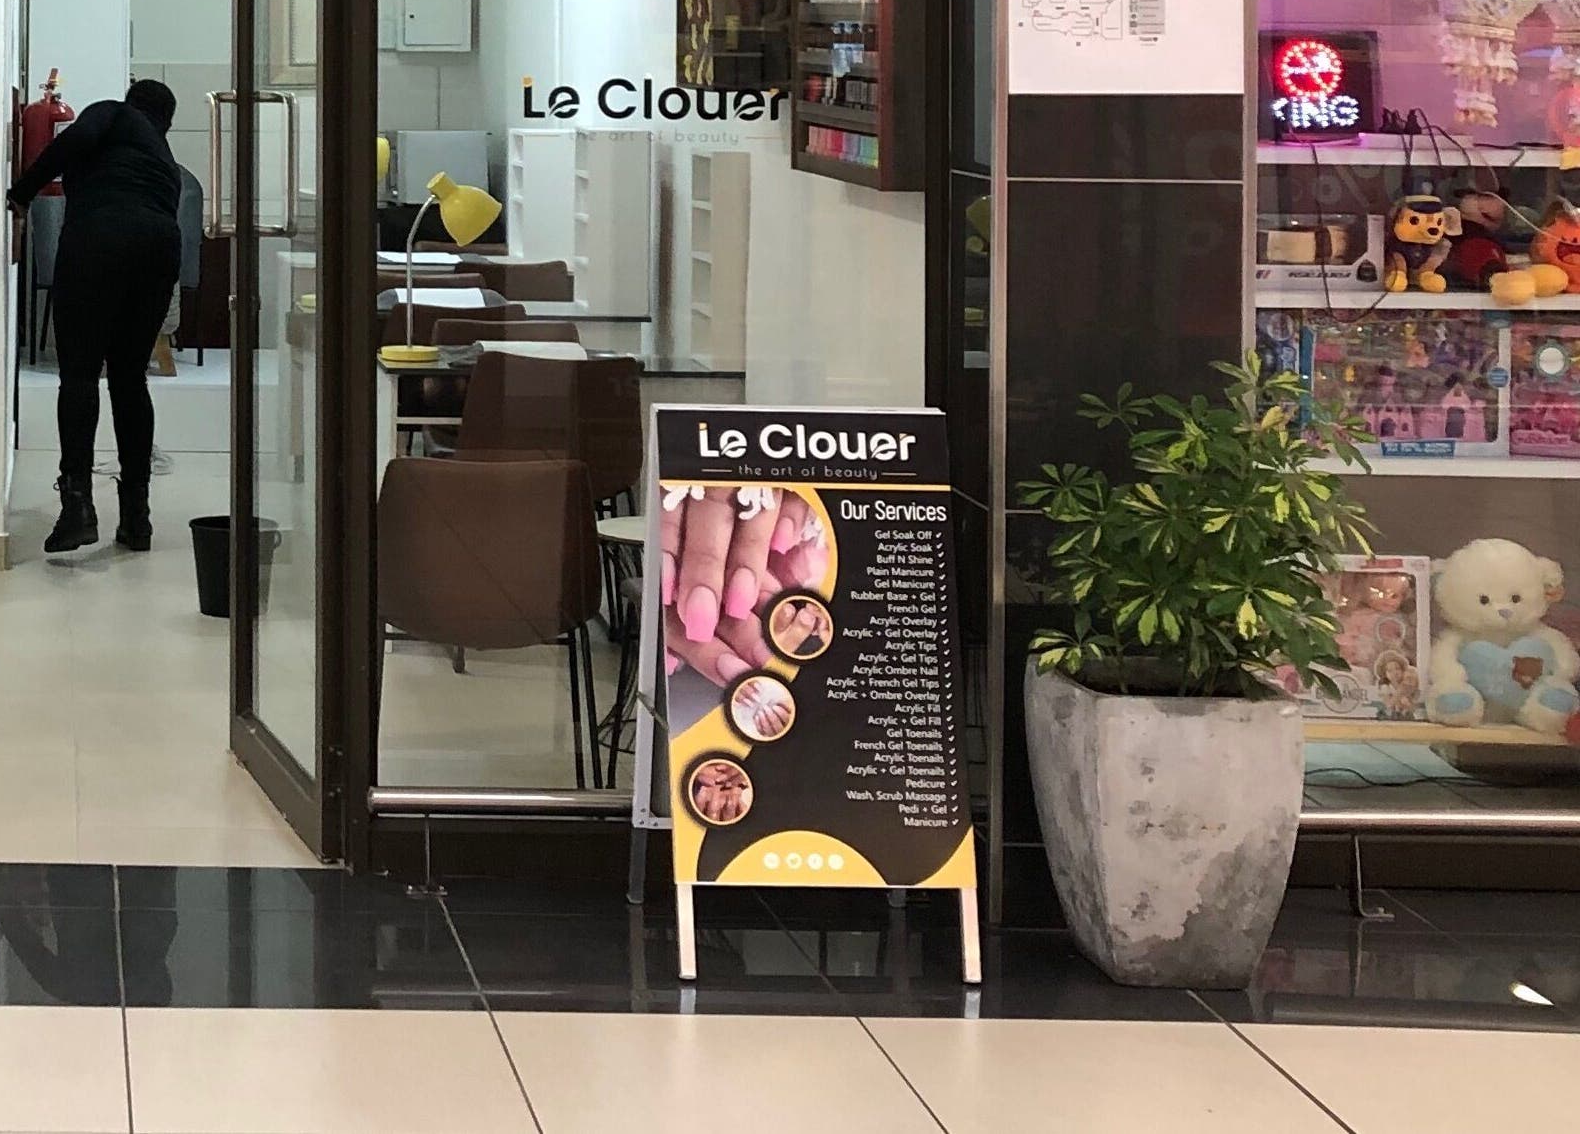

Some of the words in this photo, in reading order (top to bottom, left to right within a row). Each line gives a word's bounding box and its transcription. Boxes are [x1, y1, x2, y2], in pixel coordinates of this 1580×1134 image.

[523, 77, 580, 118] Le
[598, 78, 789, 120] Clouer
[674, 132, 740, 146] beauty
[698, 423, 748, 458] Le
[759, 423, 916, 461] Clouer
[738, 465, 762, 476] the
[771, 466, 793, 476] art
[801, 466, 815, 477] of
[825, 467, 878, 480] beauty
[841, 499, 870, 520] Our
[875, 500, 947, 522] Services
[875, 530, 890, 539] Gel
[893, 530, 915, 539] Soak
[917, 531, 932, 540] Off
[878, 543, 908, 553] Acrylic
[911, 543, 932, 552] Soak
[877, 555, 895, 563] Buff
[898, 555, 905, 563] N
[908, 555, 933, 564] Shine
[867, 567, 889, 575] Plain
[891, 567, 934, 576] Manicure
[874, 579, 890, 588] Gel
[892, 580, 935, 589] Manicure
[851, 591, 884, 600] Rubber
[887, 592, 908, 600] Base
[920, 592, 935, 601] Gel
[888, 604, 918, 613] French
[921, 604, 936, 613] Gel
[870, 616, 900, 627] Acrylic
[902, 617, 937, 628] Overlay
[843, 628, 873, 639] Acrylic
[885, 629, 900, 637] Gel
[903, 629, 938, 640] Overlay
[885, 641, 915, 652] Acrylic
[918, 641, 937, 652] Tips
[859, 653, 888, 664] Acrylic
[901, 654, 916, 662] Gel
[918, 654, 938, 665] Tips
[853, 665, 882, 676] Acrylic
[885, 666, 917, 675] Ombre
[920, 667, 938, 675] Nail
[827, 677, 857, 688] Acrylic
[869, 678, 900, 687] French
[902, 679, 918, 687] Gel
[920, 679, 939, 689] Tips
[828, 690, 857, 701] Acrylic
[870, 690, 902, 700] Ombre
[905, 691, 940, 703] Overlay
[895, 704, 925, 714] Acrylic
[928, 704, 940, 712] Fill
[868, 716, 898, 727] Acrylic
[910, 716, 926, 725] Gel
[929, 717, 941, 725] Fill
[887, 728, 903, 737] Gel
[905, 729, 942, 738] Toenails
[854, 740, 886, 750] French
[888, 741, 903, 750] Gel
[905, 741, 943, 751] Toenails
[874, 753, 905, 764] Acrylic
[907, 753, 944, 763] Toenails
[847, 765, 877, 776] Acrylic
[889, 765, 905, 775] Gel
[908, 766, 945, 775] Toenails
[906, 779, 945, 788] Pedicure
[846, 790, 874, 801] Wash,
[876, 791, 903, 800] Scrub
[905, 791, 946, 803] Massage
[899, 804, 919, 813] Pedi
[931, 805, 947, 814] Gel
[904, 817, 948, 827] Manicure
